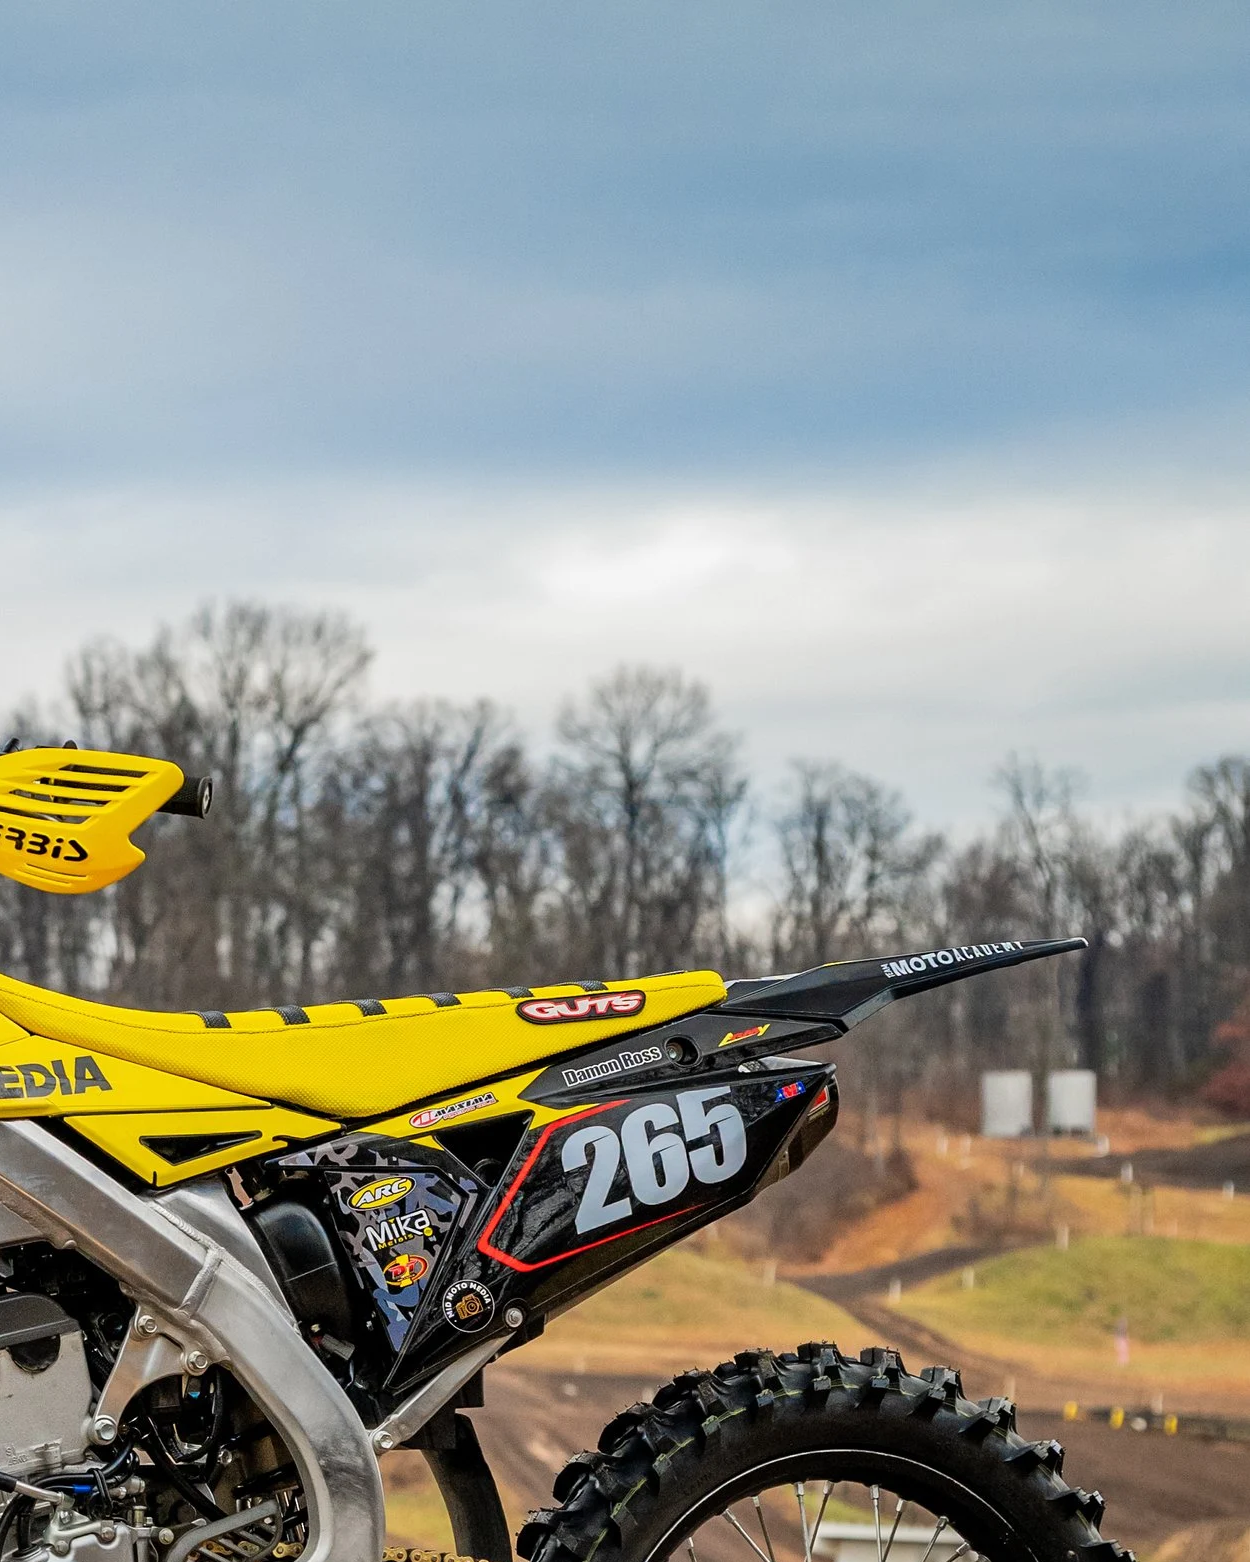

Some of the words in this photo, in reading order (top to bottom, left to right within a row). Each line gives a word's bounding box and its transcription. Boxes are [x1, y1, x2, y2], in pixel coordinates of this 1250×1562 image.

[522, 992, 644, 1019] GUTS
[562, 1061, 622, 1087] Damon
[620, 1046, 662, 1069] Ross
[561, 1086, 748, 1235] 265
[357, 1177, 409, 1208] ARC
[365, 1209, 430, 1252] Mika
[446, 1282, 468, 1301] MOTO
[469, 1282, 491, 1304] MEDIA
[445, 1301, 455, 1319] MID
